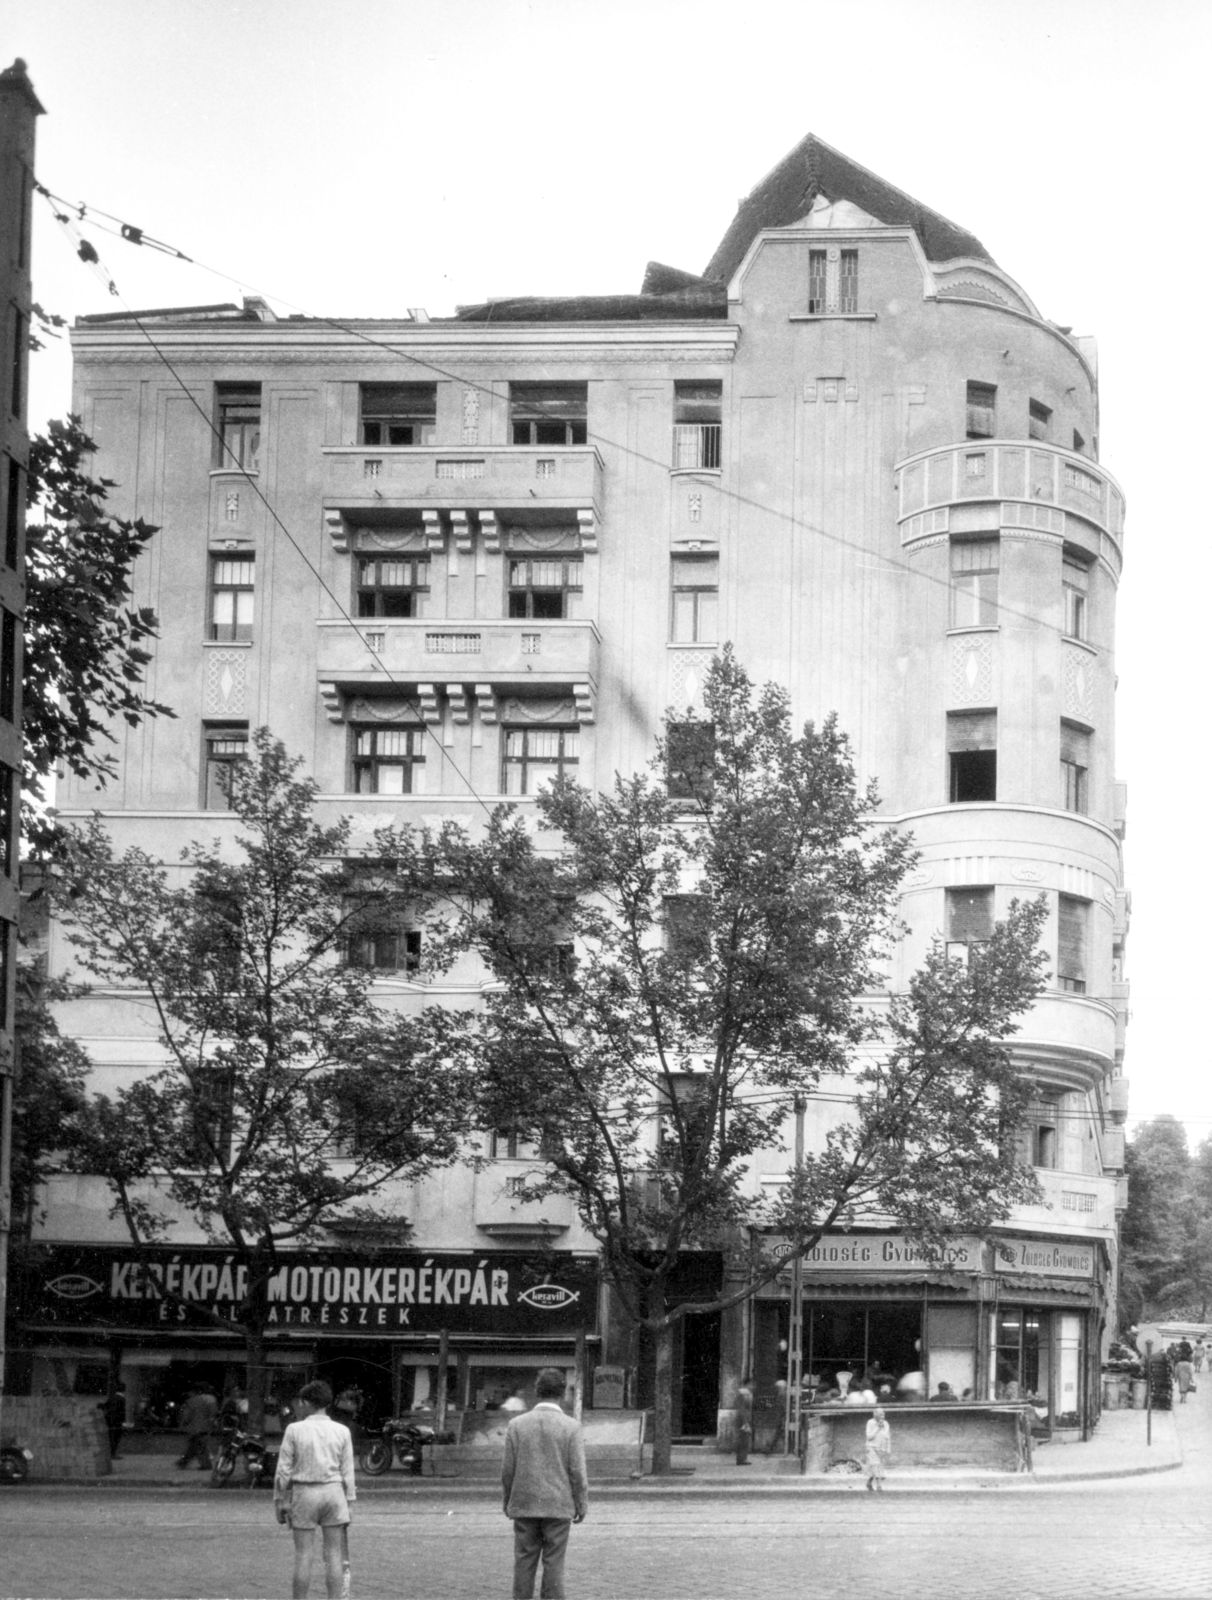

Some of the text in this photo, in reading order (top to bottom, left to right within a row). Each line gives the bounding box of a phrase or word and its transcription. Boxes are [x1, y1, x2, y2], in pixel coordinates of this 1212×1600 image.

[110, 1255, 510, 1306] KERÉKPÁR MOTORKERÉKPÁR
[532, 1290, 565, 1301] keravill
[159, 1300, 411, 1324] ÉS ALATRÉSZEK
